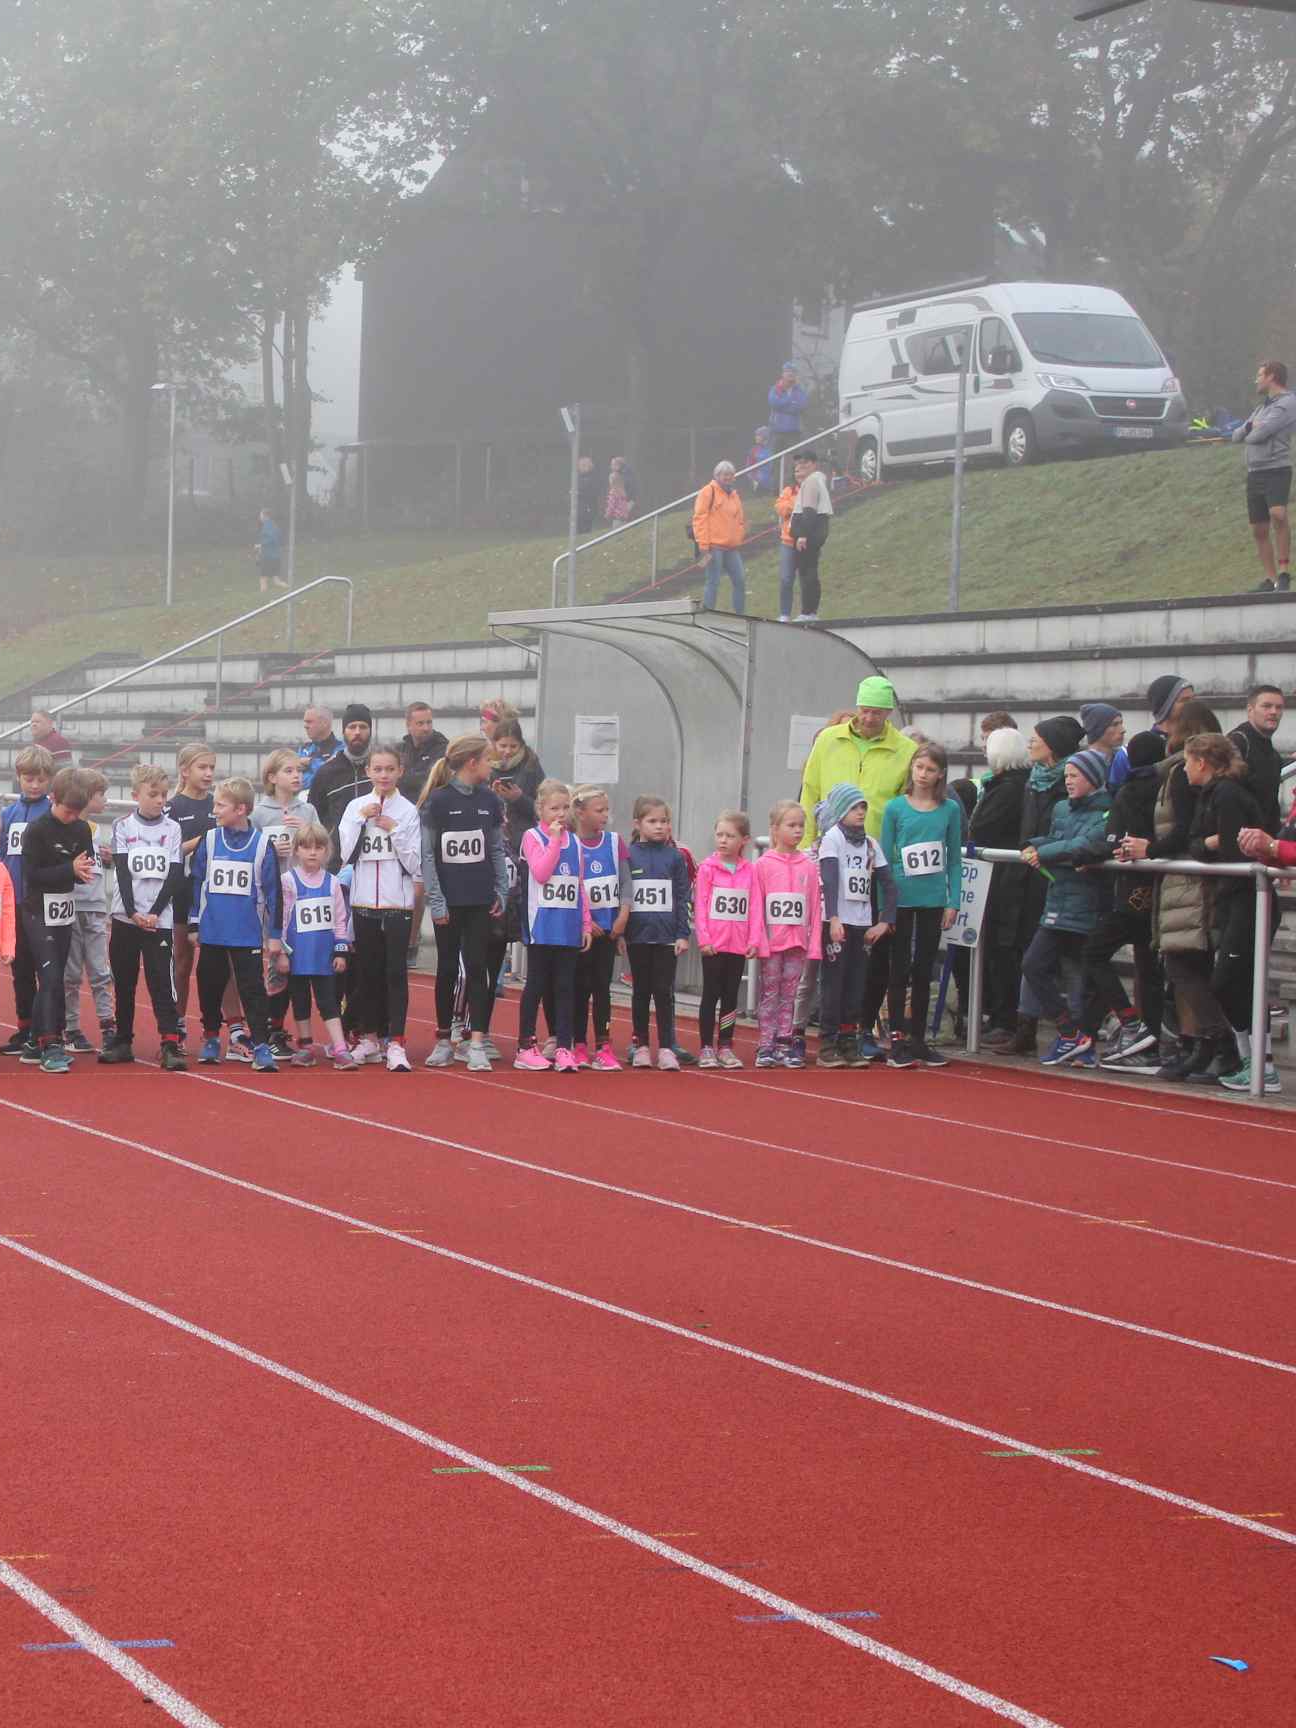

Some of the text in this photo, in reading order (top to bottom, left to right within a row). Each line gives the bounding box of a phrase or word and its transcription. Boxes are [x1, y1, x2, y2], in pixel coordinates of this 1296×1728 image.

[362, 835, 393, 854] 641
[446, 838, 481, 857] 640
[132, 854, 166, 872] 603
[907, 849, 940, 869] 612
[213, 868, 249, 888] 616
[961, 865, 978, 883] op
[543, 883, 576, 902] 646
[590, 882, 619, 903] 614
[634, 887, 667, 905] 451
[48, 900, 74, 920] 620
[300, 905, 332, 924] 615
[715, 895, 747, 915] 630
[770, 900, 803, 918] 629
